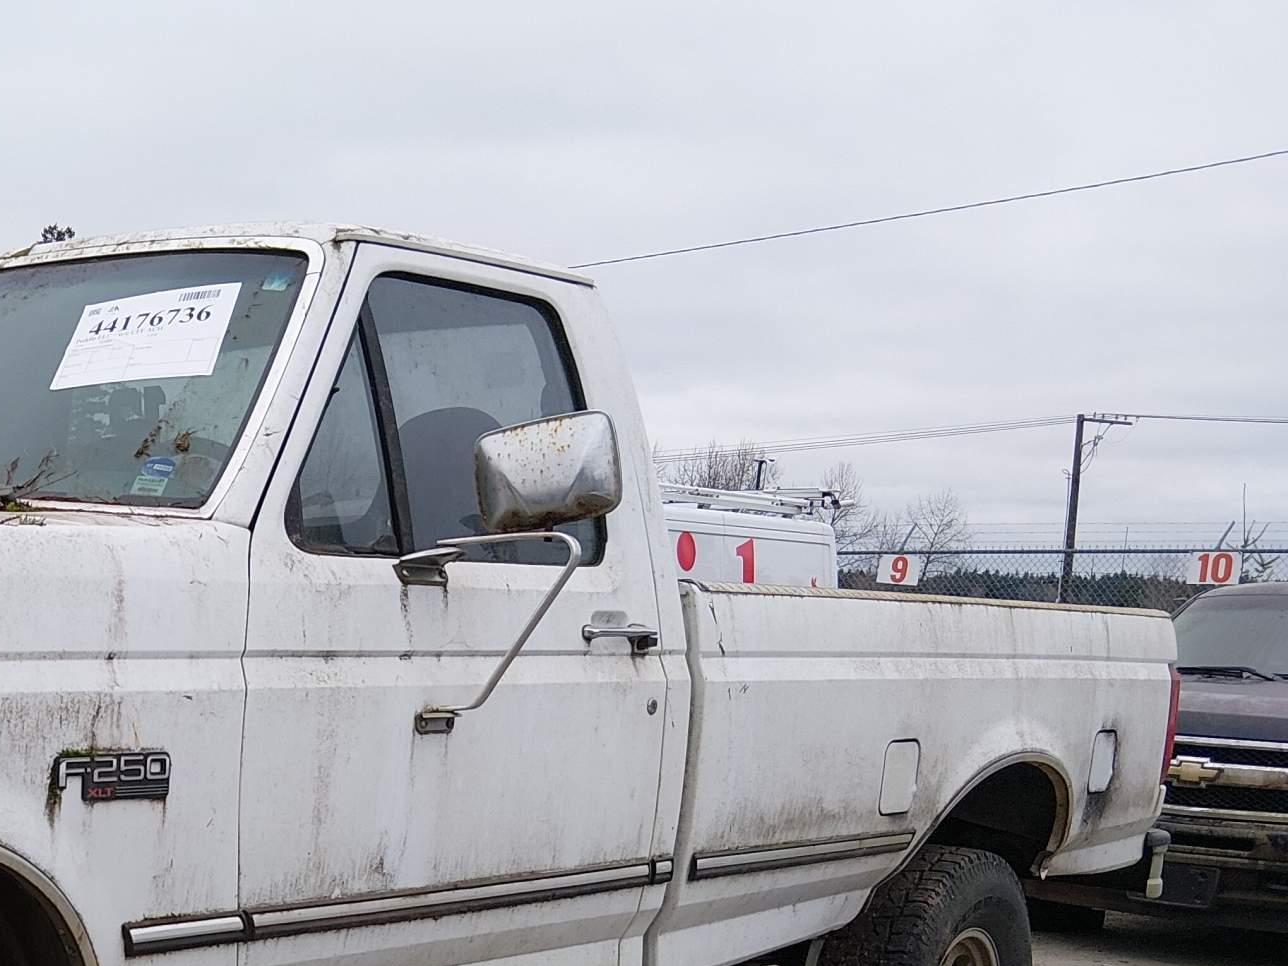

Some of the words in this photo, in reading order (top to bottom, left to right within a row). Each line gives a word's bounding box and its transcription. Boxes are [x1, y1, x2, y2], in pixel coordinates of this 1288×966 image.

[88, 304, 214, 335] 44176736
[889, 556, 909, 584] 9
[1198, 553, 1233, 583] 10
[87, 787, 113, 798] XLT
